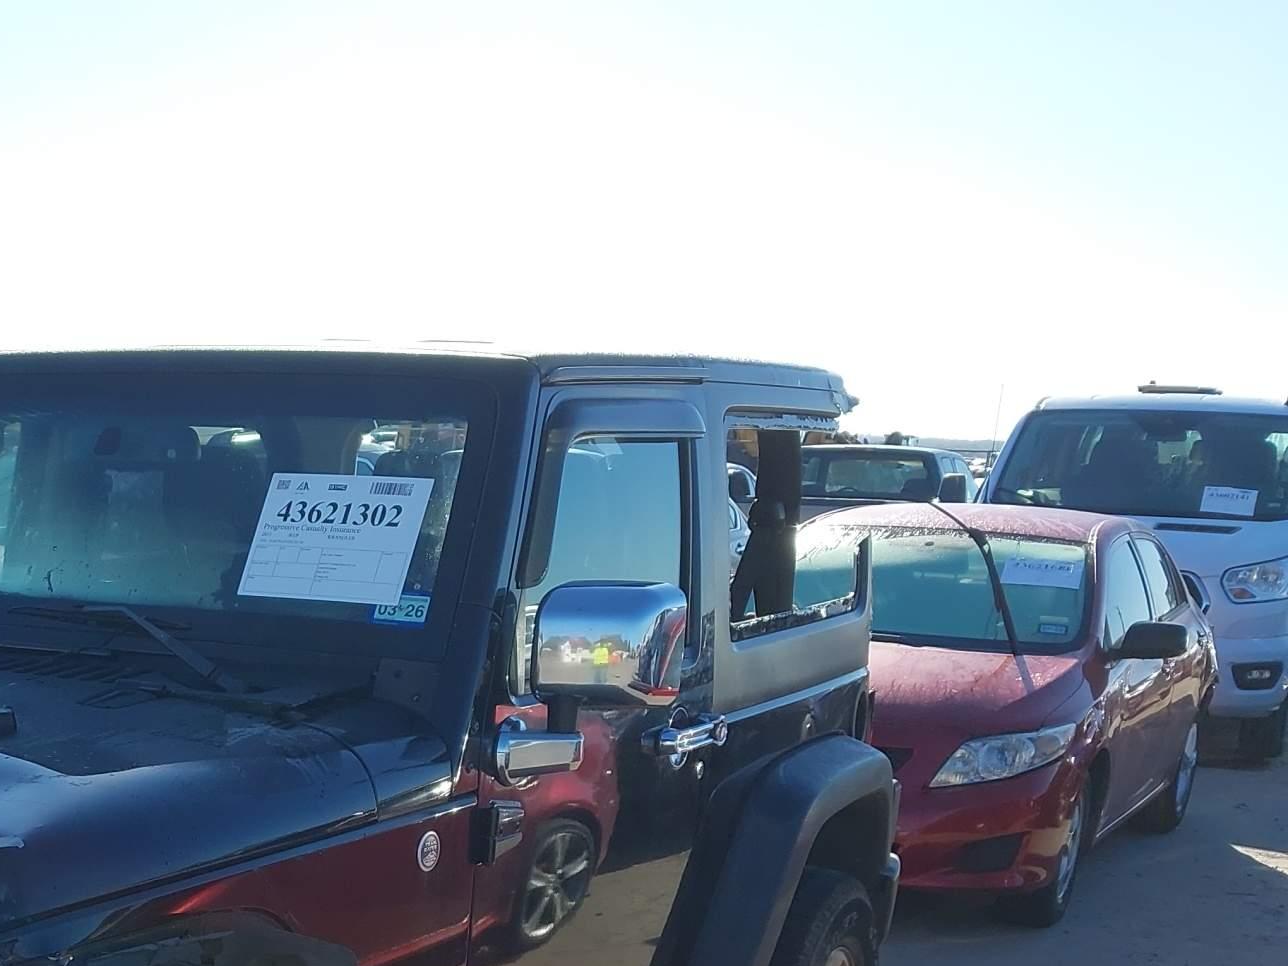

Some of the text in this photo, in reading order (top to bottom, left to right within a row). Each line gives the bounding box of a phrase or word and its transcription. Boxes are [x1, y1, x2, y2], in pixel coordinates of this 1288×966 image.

[276, 500, 403, 527] 43621302
[263, 522, 362, 534] Progressive Casualty Insurance
[378, 604, 425, 618] 03 26
